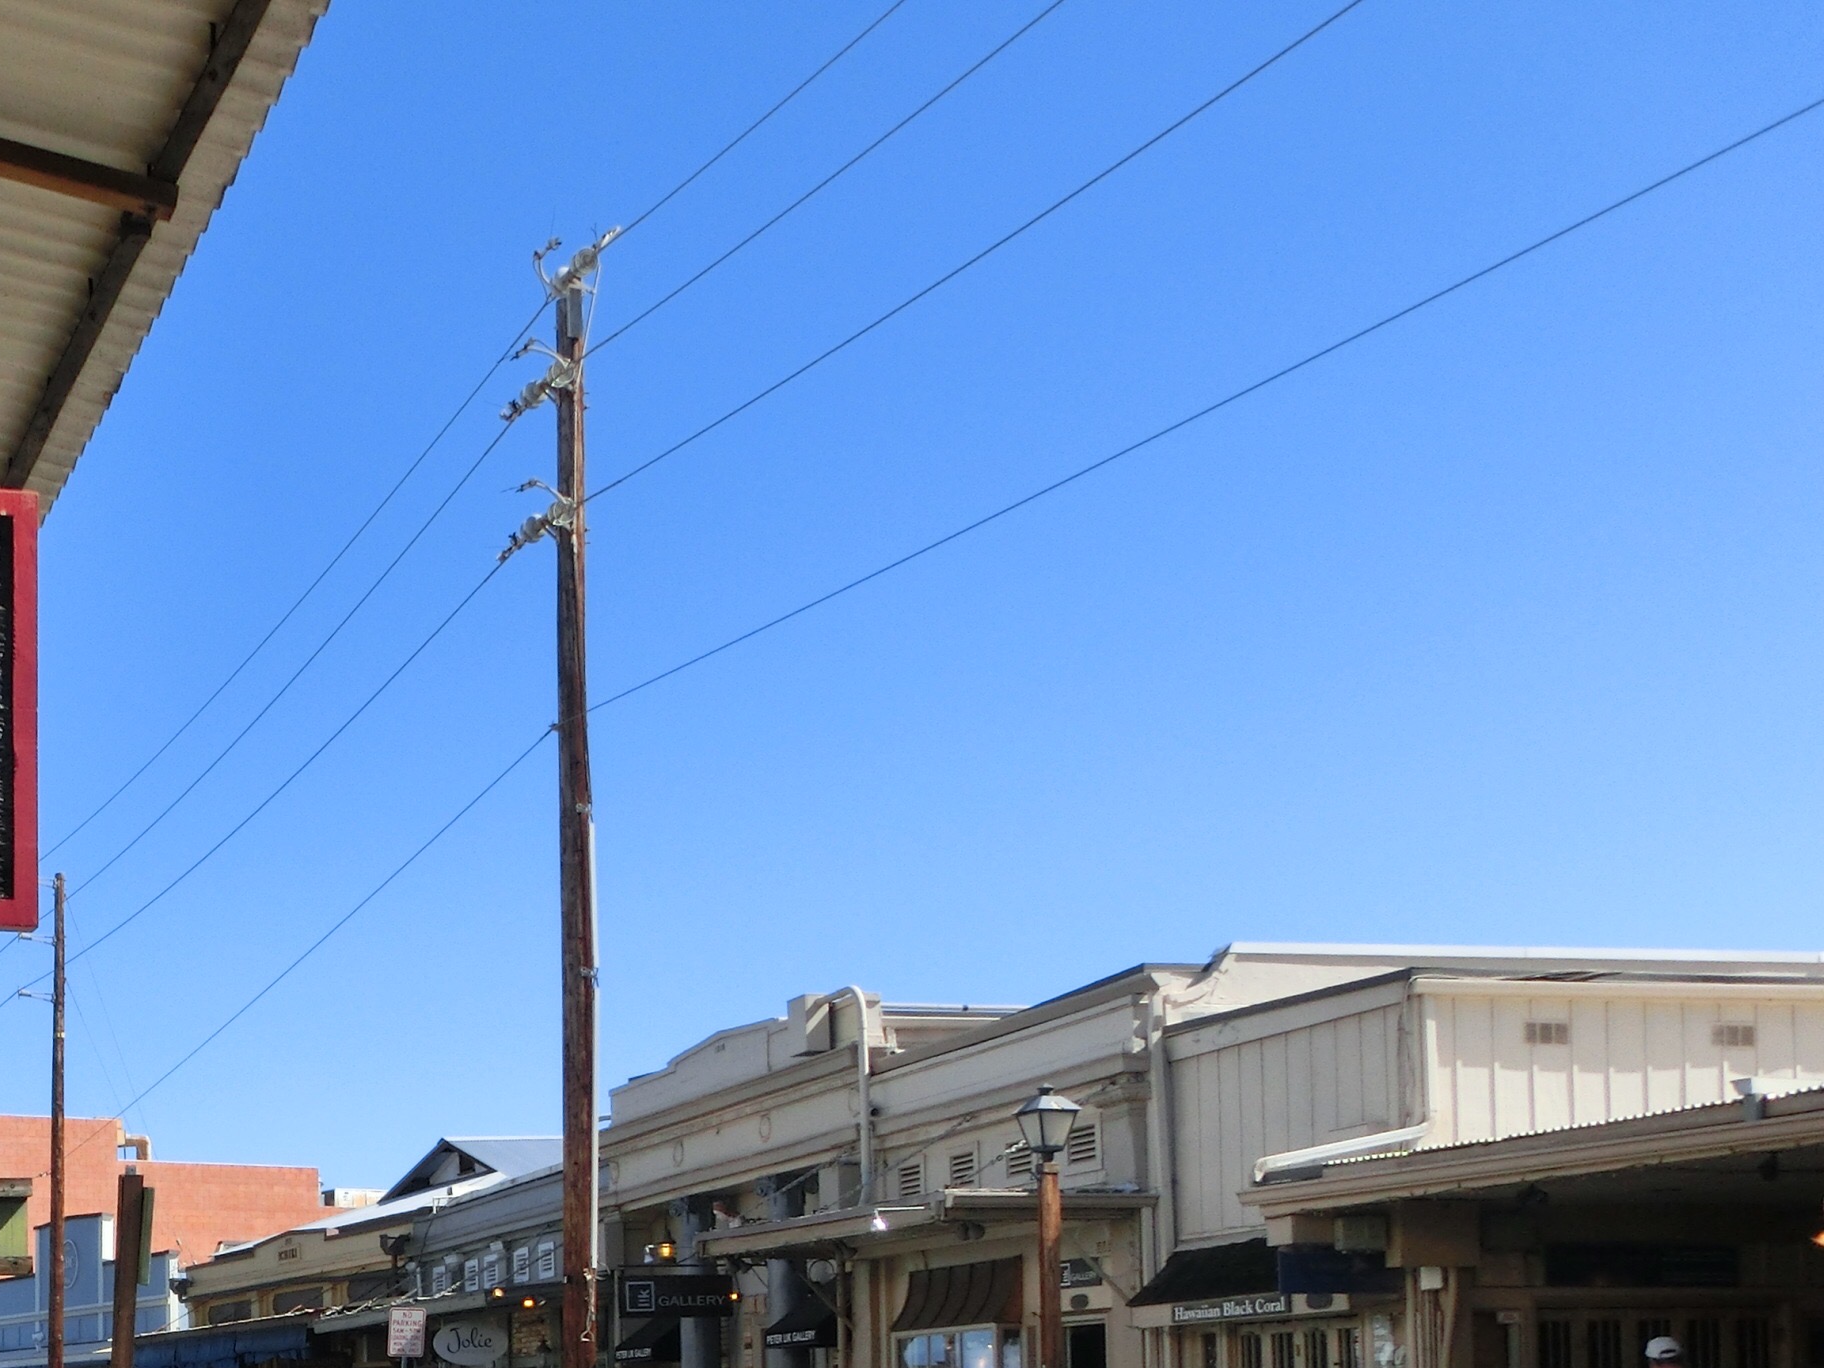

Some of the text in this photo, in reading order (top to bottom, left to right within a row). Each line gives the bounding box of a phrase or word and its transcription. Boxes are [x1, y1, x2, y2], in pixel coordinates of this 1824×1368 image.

[658, 1295, 725, 1307] GALLERY
[1174, 1296, 1285, 1321] Hawaiian Black Coral
[393, 1320, 423, 1329] PARKING
[447, 1327, 492, 1354] Jolie
[766, 1332, 783, 1345] PETER
[792, 1329, 816, 1342] GALLERY
